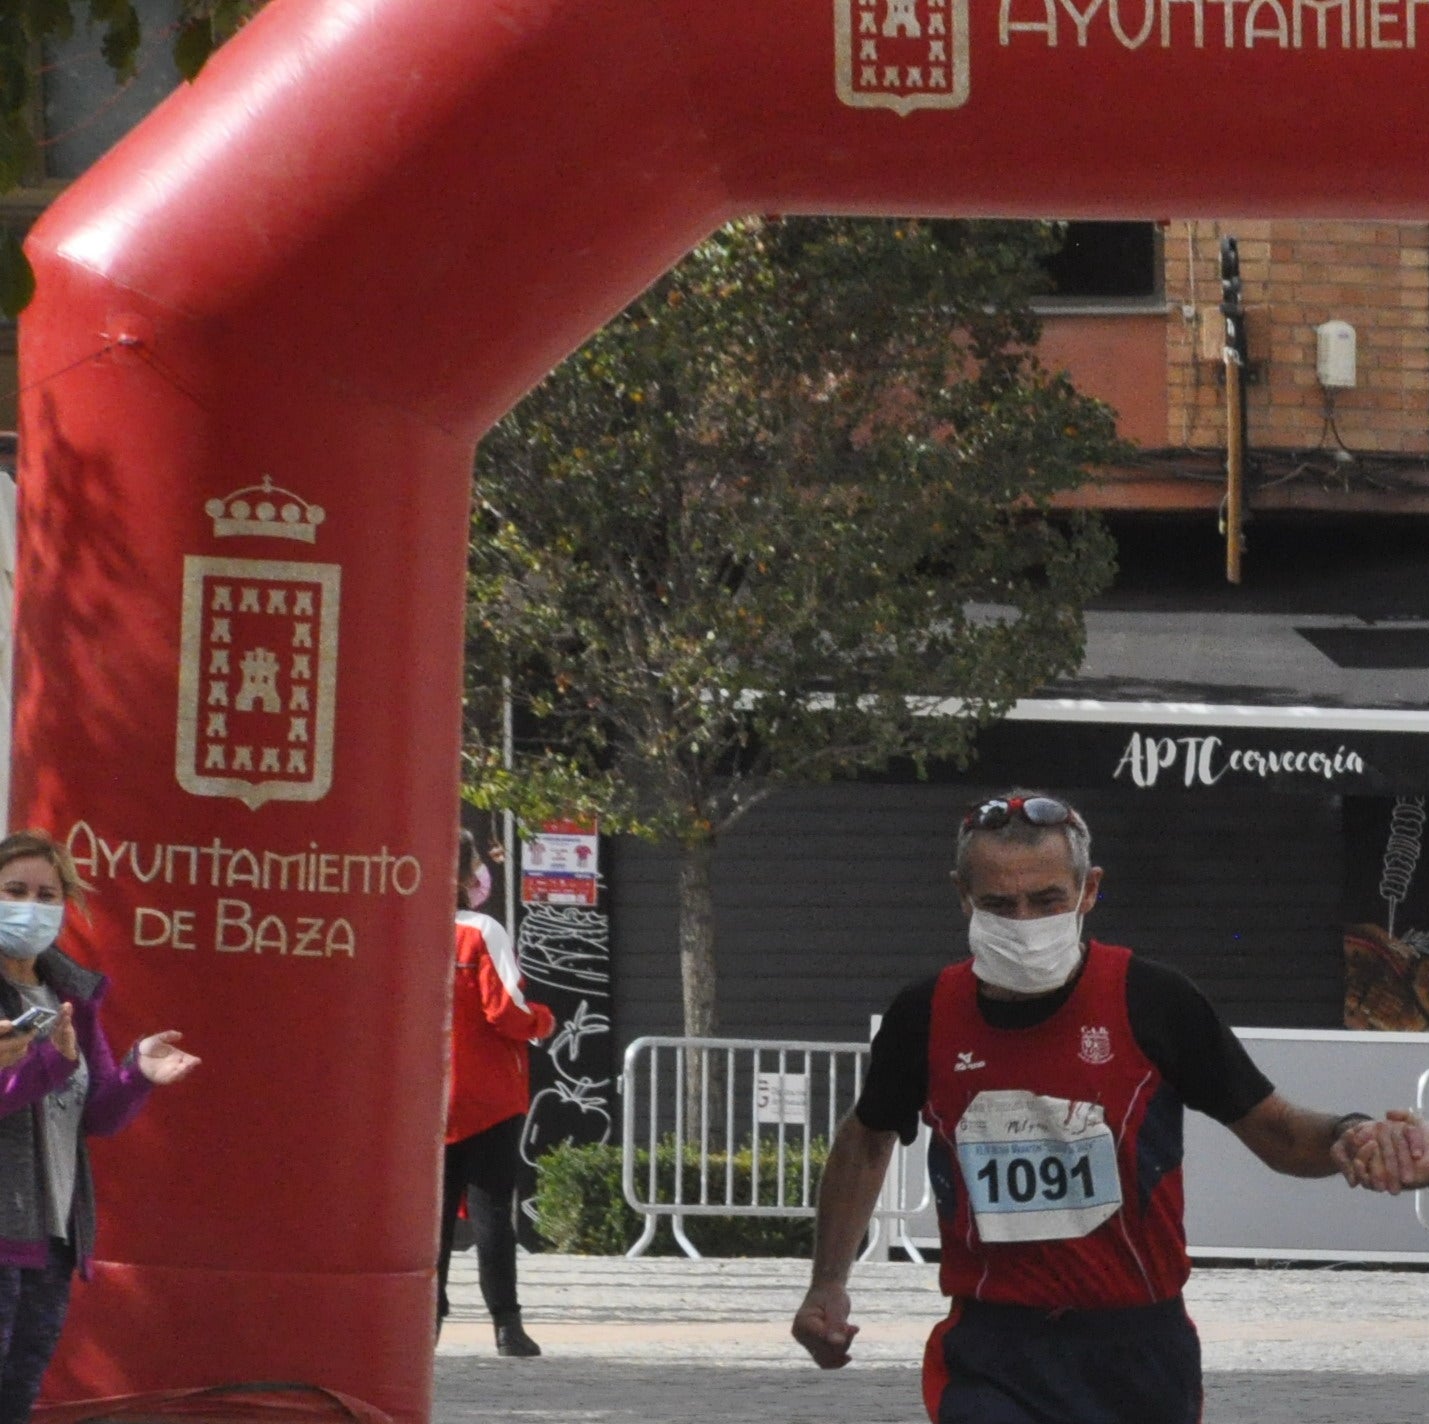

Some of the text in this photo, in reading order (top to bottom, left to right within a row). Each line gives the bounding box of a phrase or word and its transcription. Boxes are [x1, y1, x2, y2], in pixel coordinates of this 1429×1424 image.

[134, 898, 355, 957] DE BAZA
[977, 1154, 1096, 1204] 1091
